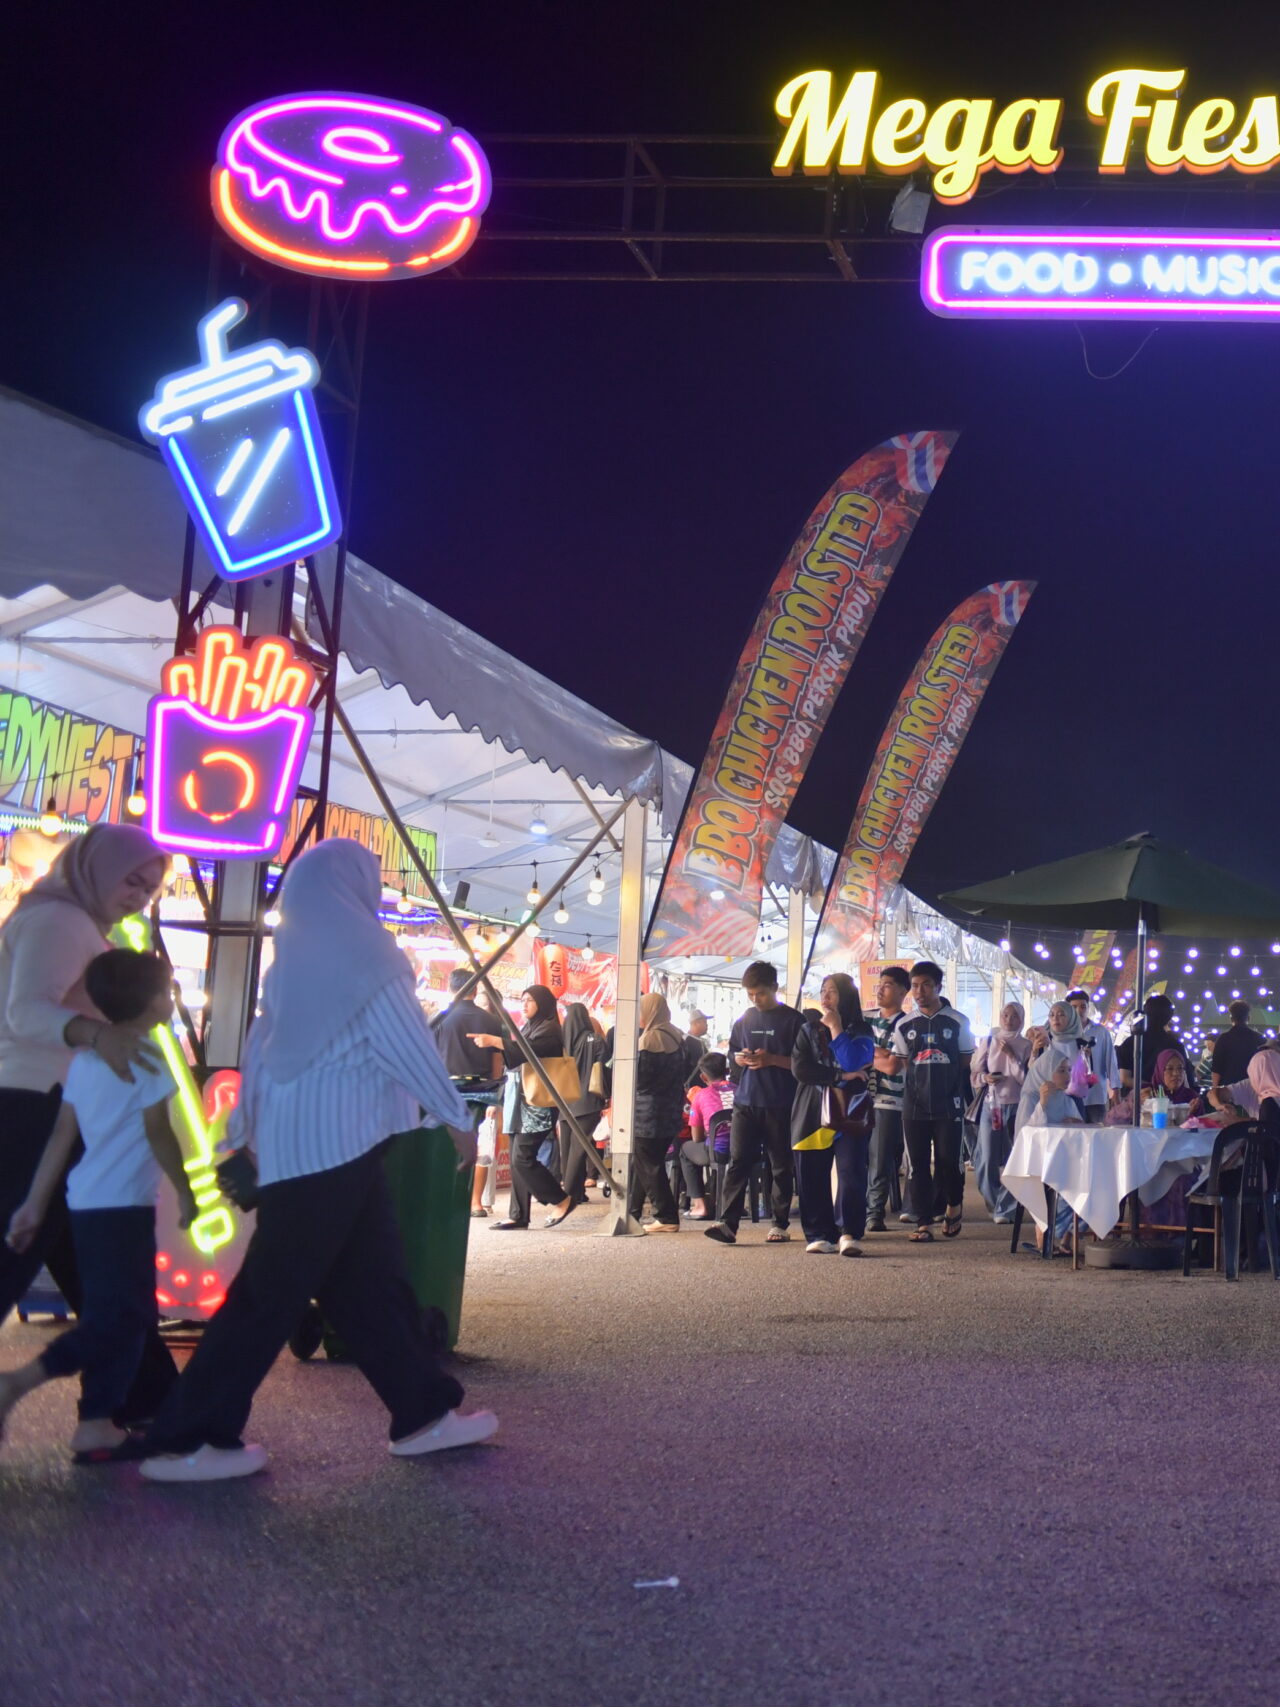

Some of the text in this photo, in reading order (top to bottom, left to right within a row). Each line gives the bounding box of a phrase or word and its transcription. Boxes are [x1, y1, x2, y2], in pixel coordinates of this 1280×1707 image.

[774, 69, 1064, 204] Mega
[960, 251, 1099, 293] FOOD
[684, 490, 882, 892] BBQ CHICKEN ROASTED
[764, 586, 870, 808] SOS BBQ PERCIK PADU
[858, 735, 930, 851] CHICKEN
[898, 624, 980, 747] ROASTED
[893, 694, 973, 853] SOS BBQ PERCIK PADU
